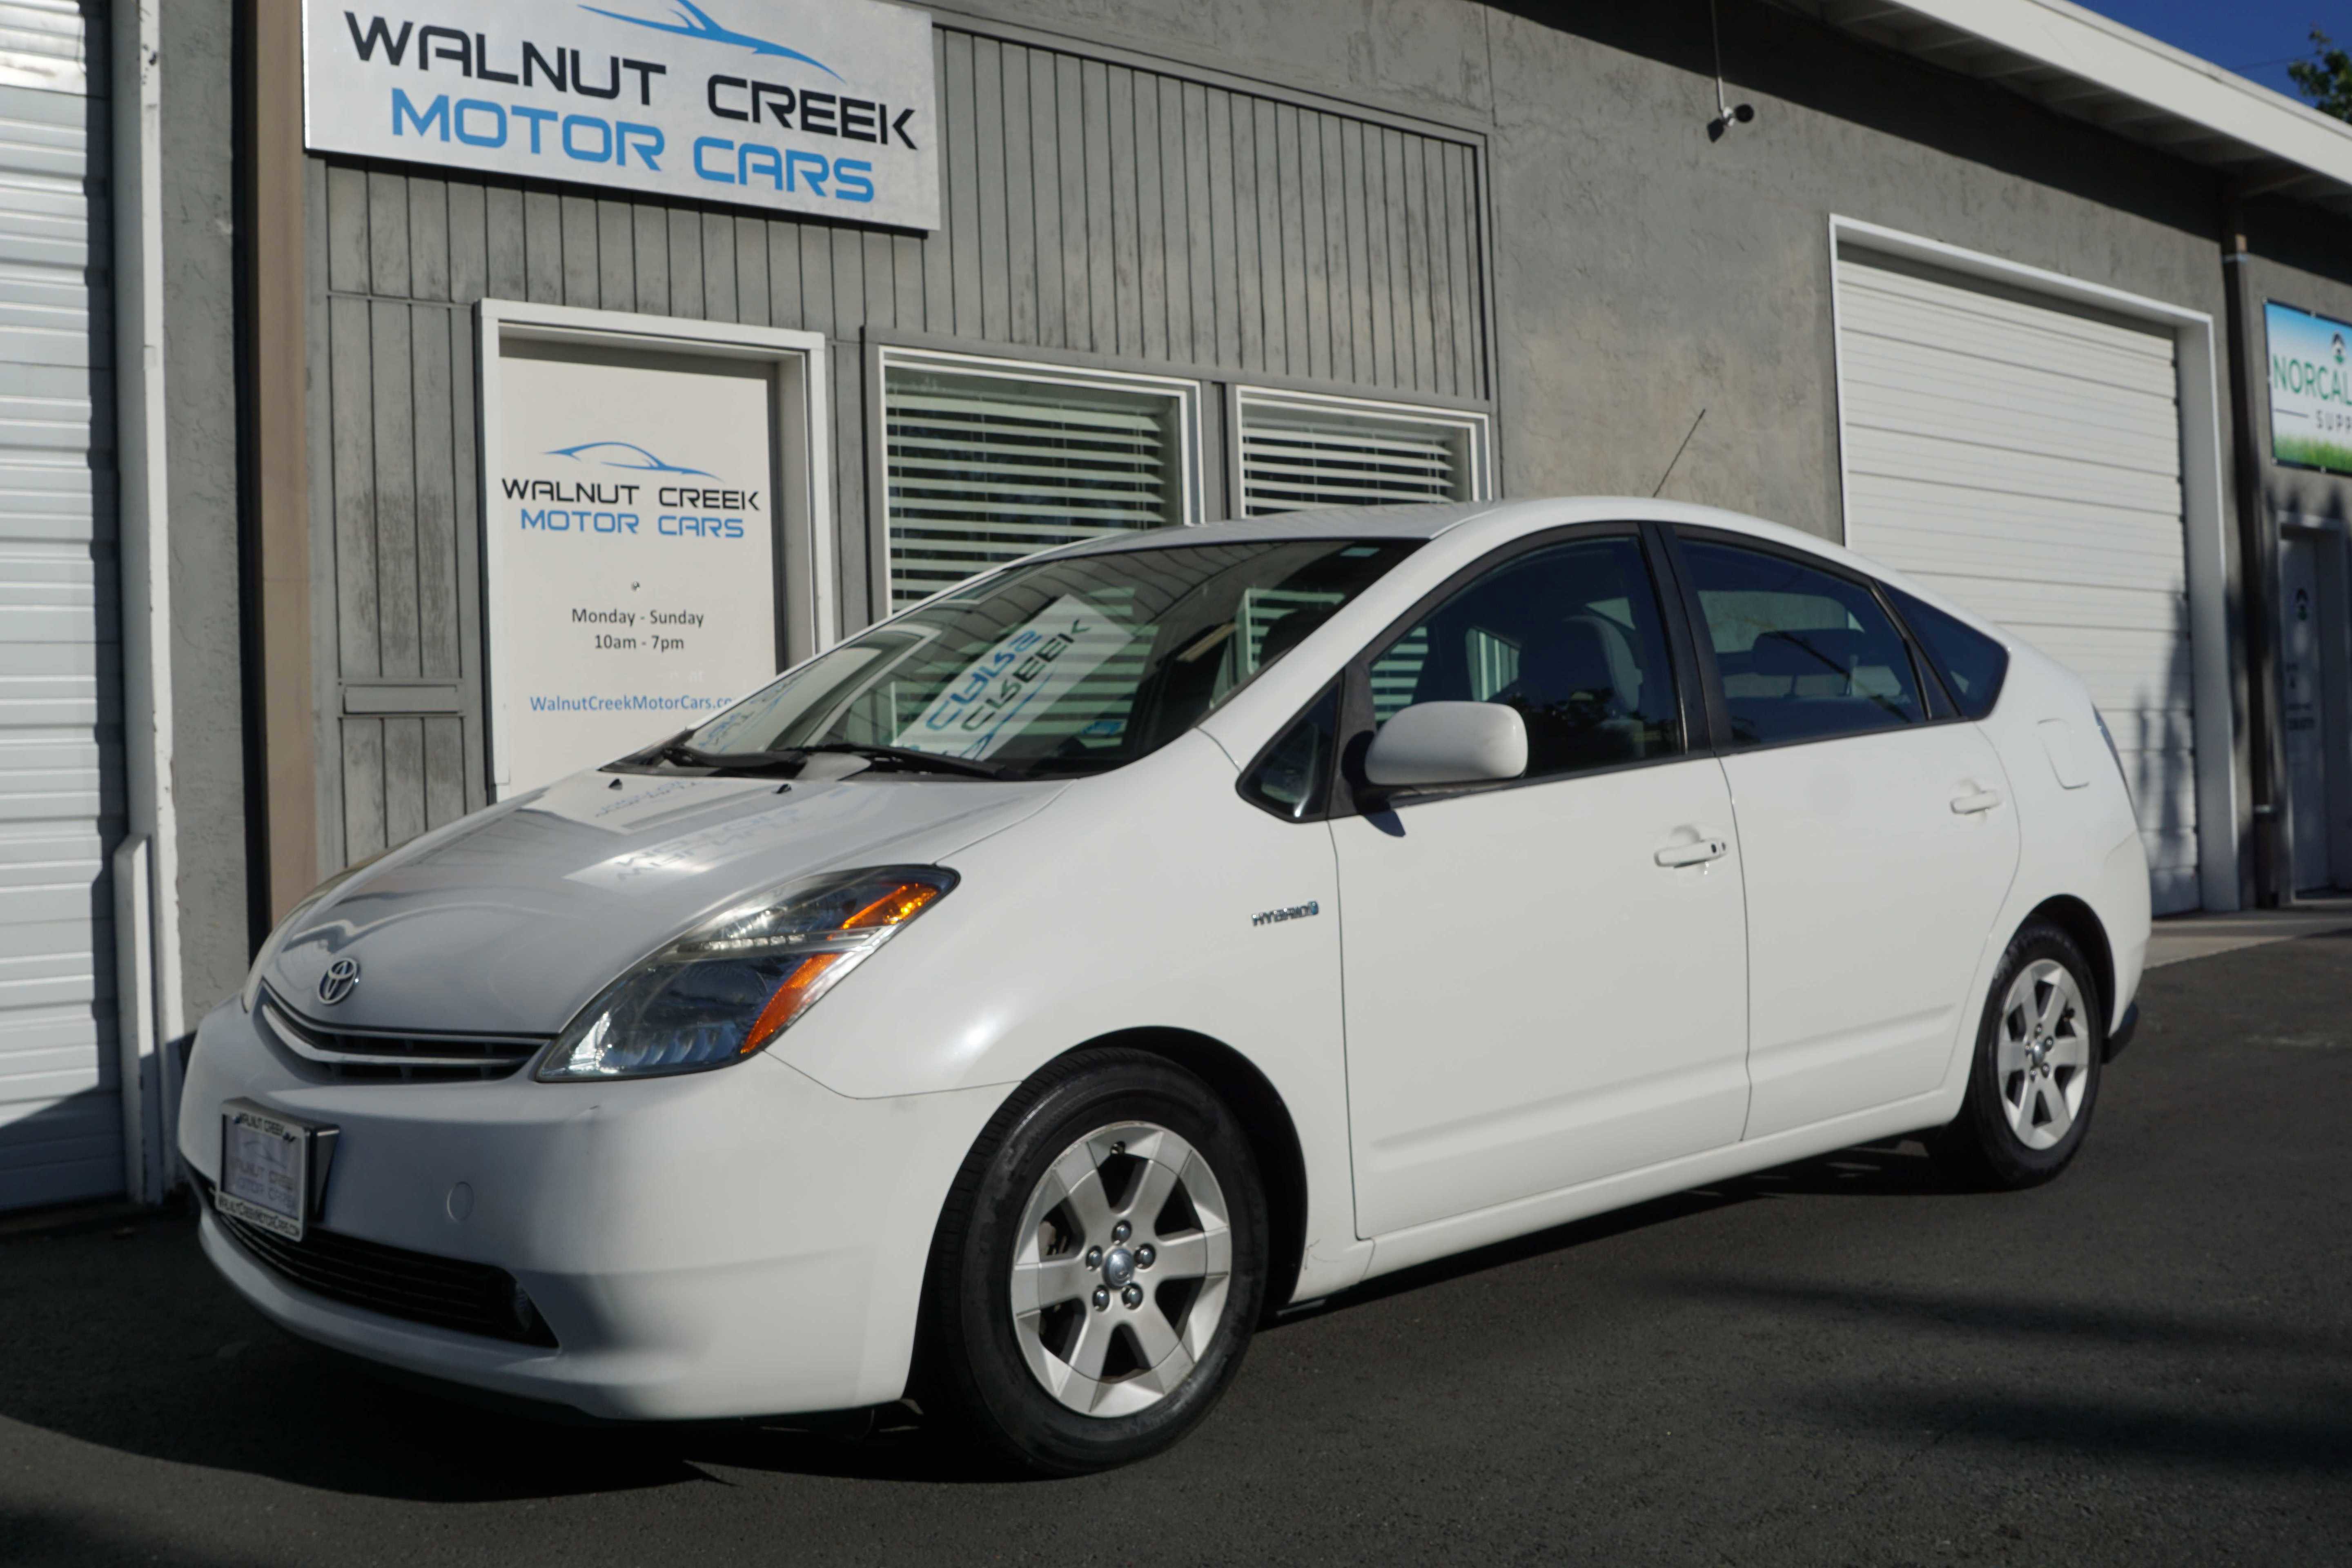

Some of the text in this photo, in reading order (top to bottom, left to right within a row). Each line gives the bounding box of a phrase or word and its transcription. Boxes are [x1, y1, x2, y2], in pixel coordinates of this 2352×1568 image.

[345, 11, 918, 150] WALNUT CREEK
[391, 87, 875, 203] MOTOR CARS
[2273, 353, 2352, 406] NORCAL
[502, 478, 760, 511] WALNUT CREEK
[521, 508, 745, 538] MOTOR CARS
[572, 608, 635, 627] Monday
[650, 610, 704, 628] Sunday
[595, 634, 637, 649] 10am
[651, 635, 684, 653] 7pm
[530, 695, 733, 710] WalnutCreekMotorCars.co
